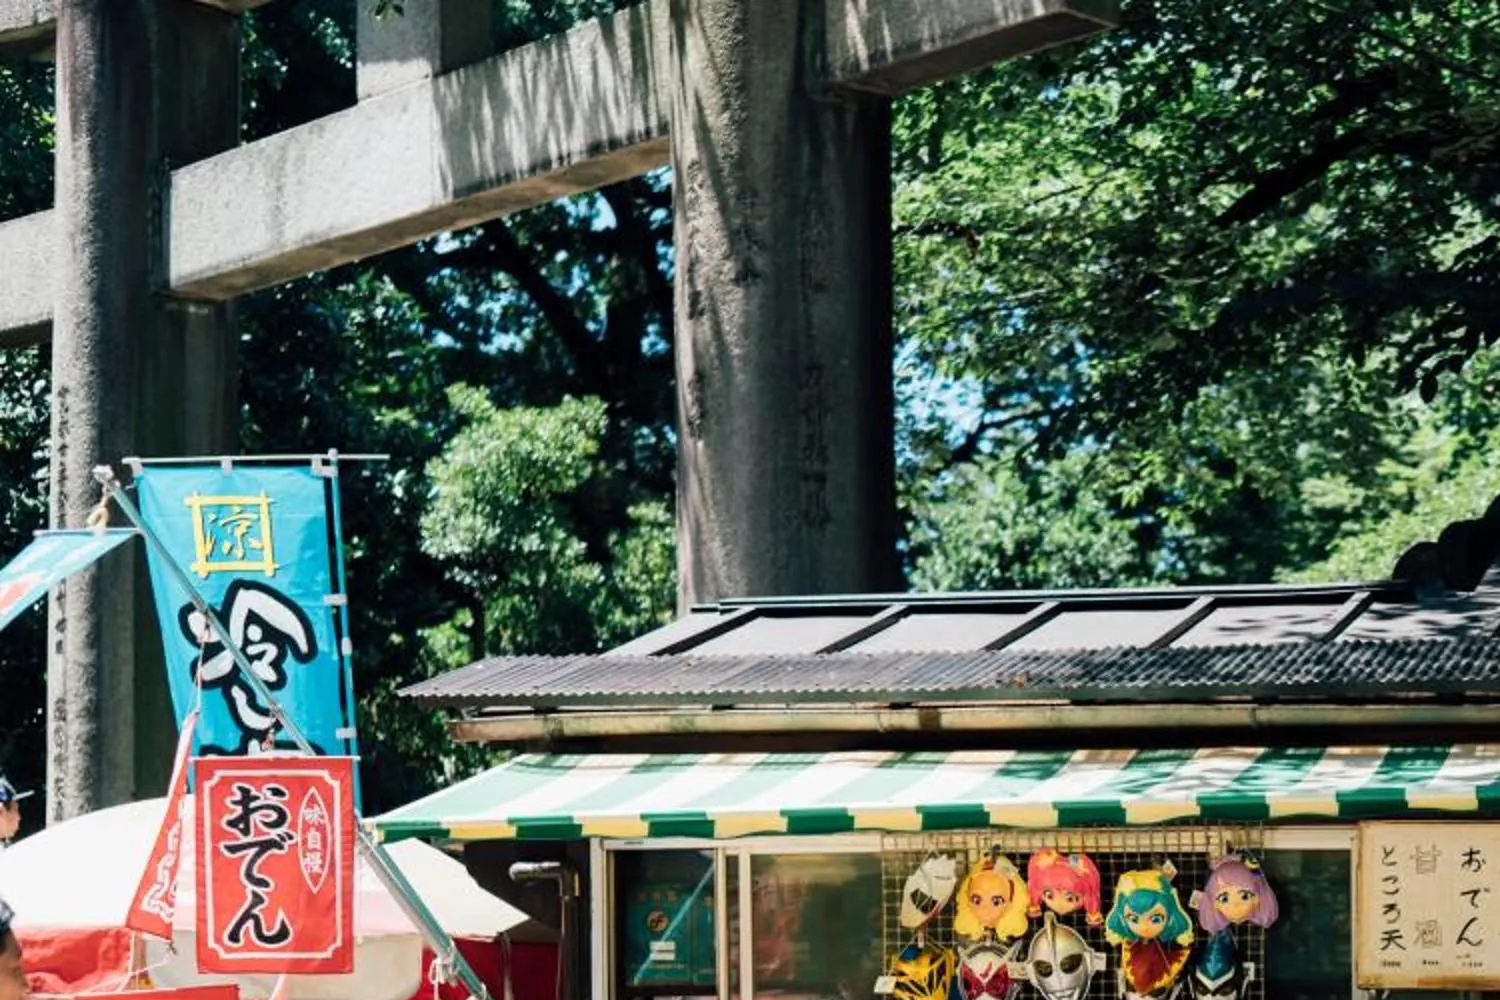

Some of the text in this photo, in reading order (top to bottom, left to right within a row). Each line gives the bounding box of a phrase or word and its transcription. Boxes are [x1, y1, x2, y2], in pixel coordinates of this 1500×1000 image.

[205, 507, 263, 560] 涼
[221, 783, 299, 947] おでん
[303, 806, 326, 875] 味自慢
[1379, 846, 1406, 951] ところ天
[1456, 847, 1490, 947] おでん
